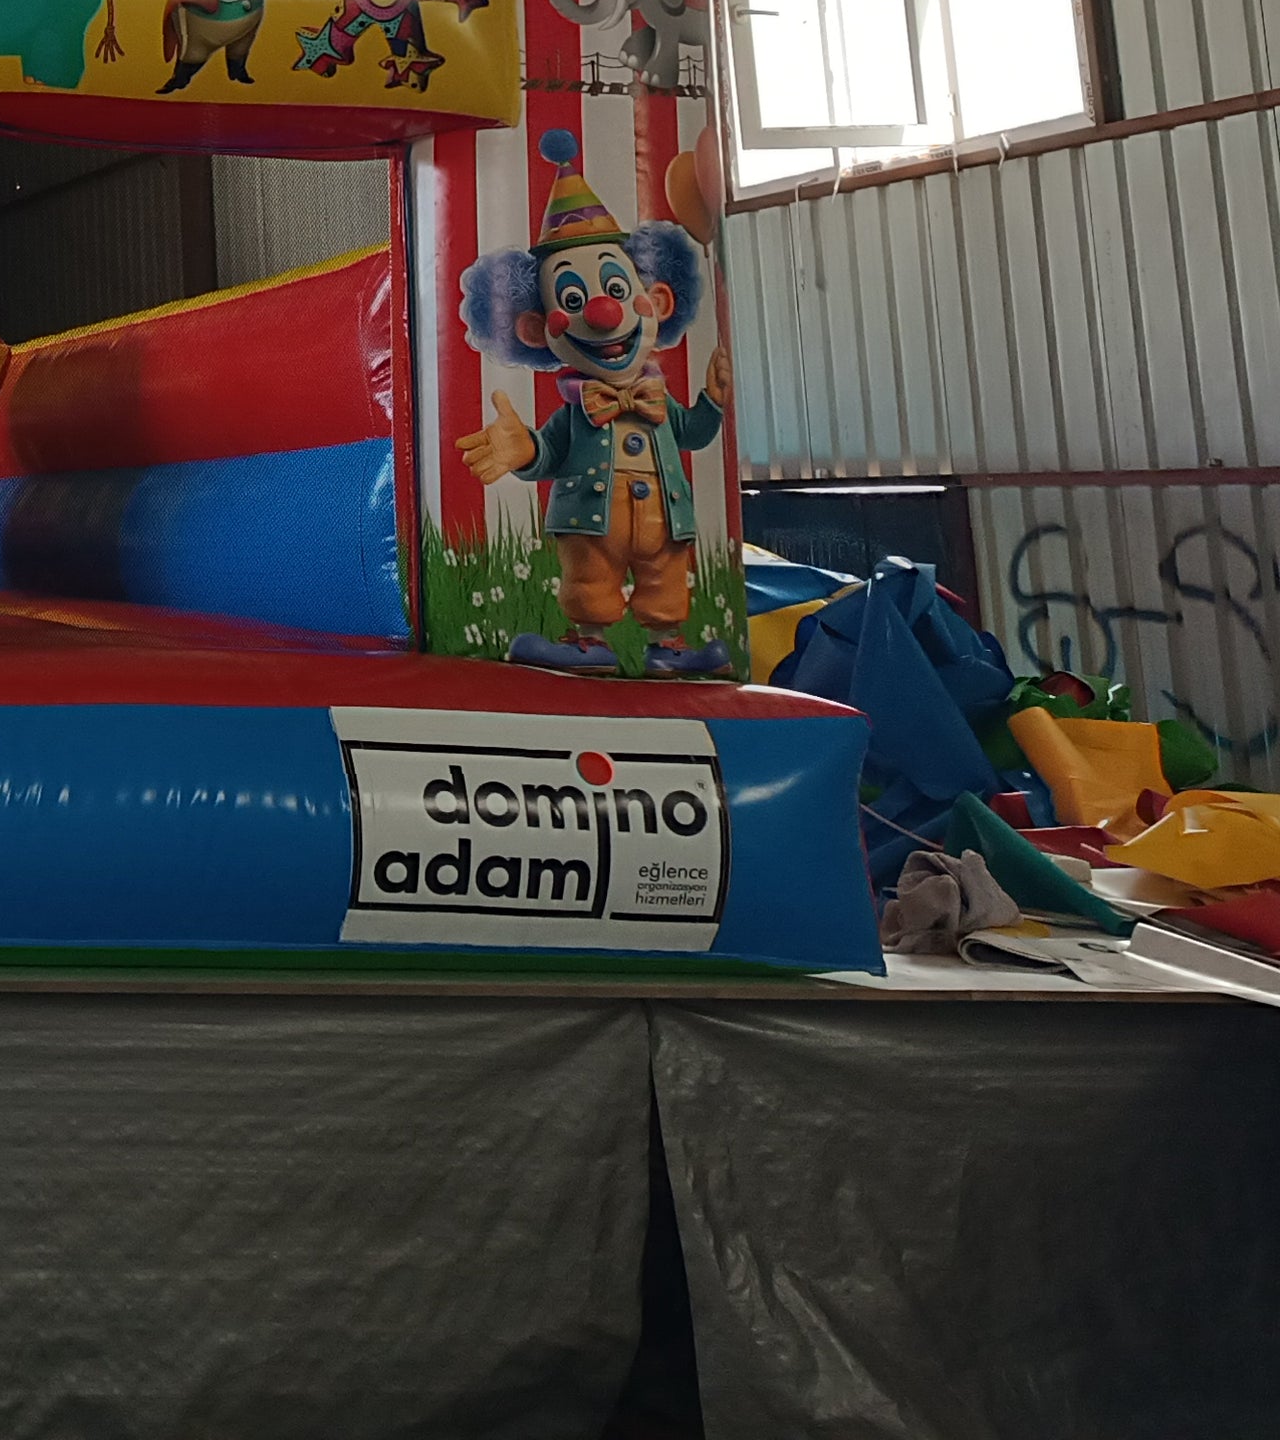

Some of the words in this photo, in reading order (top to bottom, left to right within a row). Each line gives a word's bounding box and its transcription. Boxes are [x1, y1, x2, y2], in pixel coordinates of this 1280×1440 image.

[423, 751, 708, 837] domino
[373, 838, 592, 902] adam
[638, 861, 709, 881] eğlence
[634, 891, 707, 906] hizmetleri
